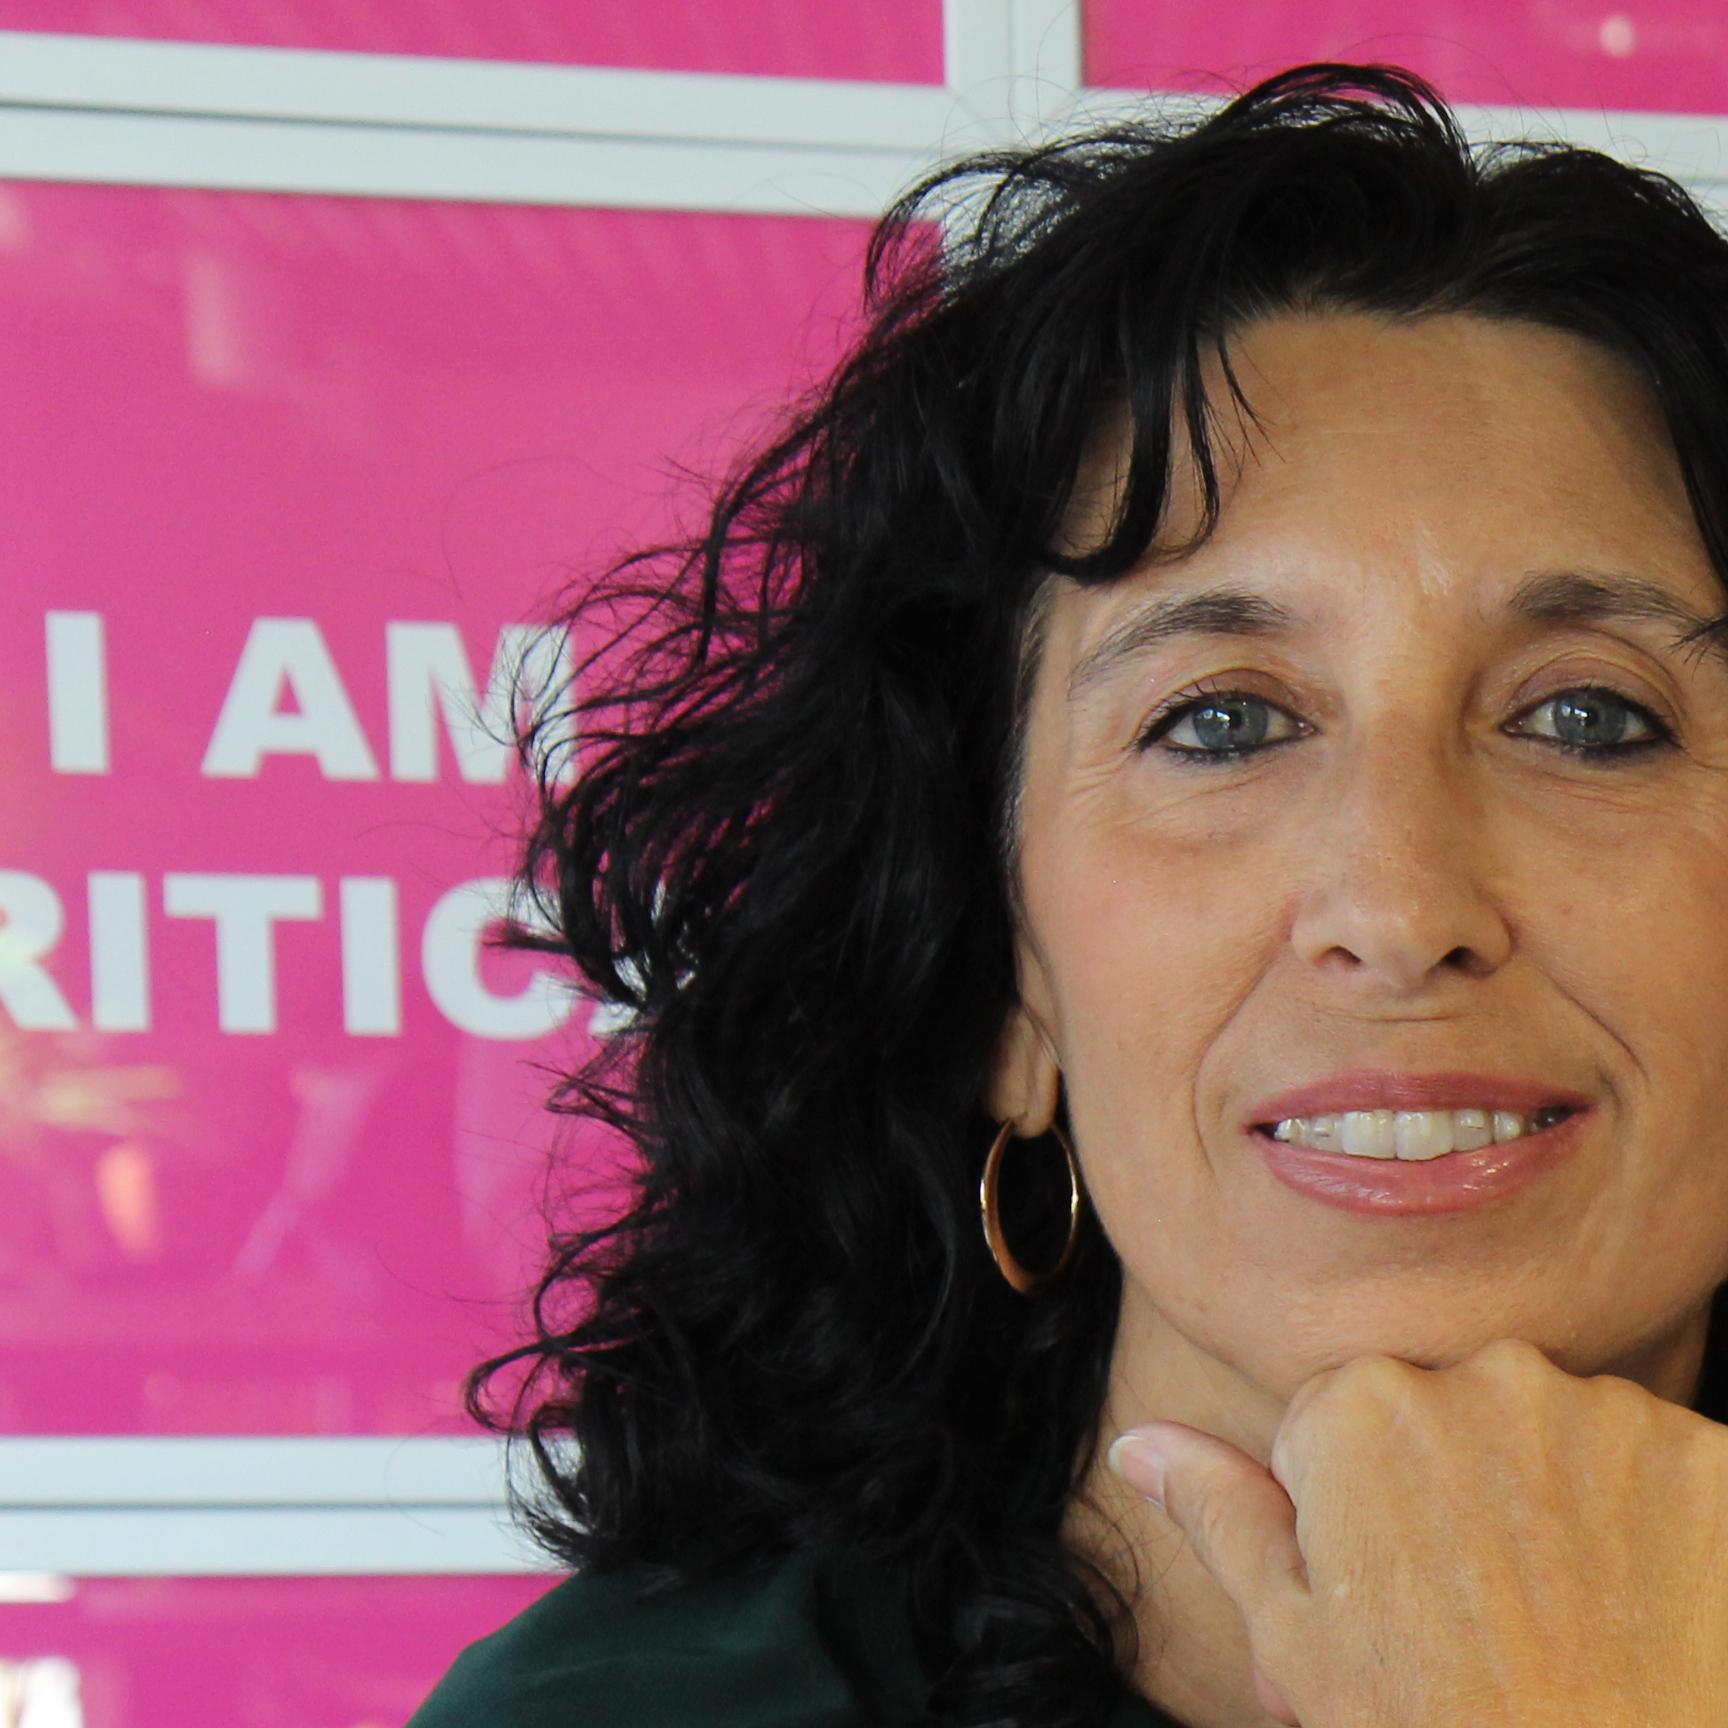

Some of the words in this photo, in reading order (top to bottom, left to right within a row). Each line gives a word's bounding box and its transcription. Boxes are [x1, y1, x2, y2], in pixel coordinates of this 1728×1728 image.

[45, 610, 110, 775] I
[201, 615, 577, 784] AM
[0, 869, 697, 1040] RITIC
